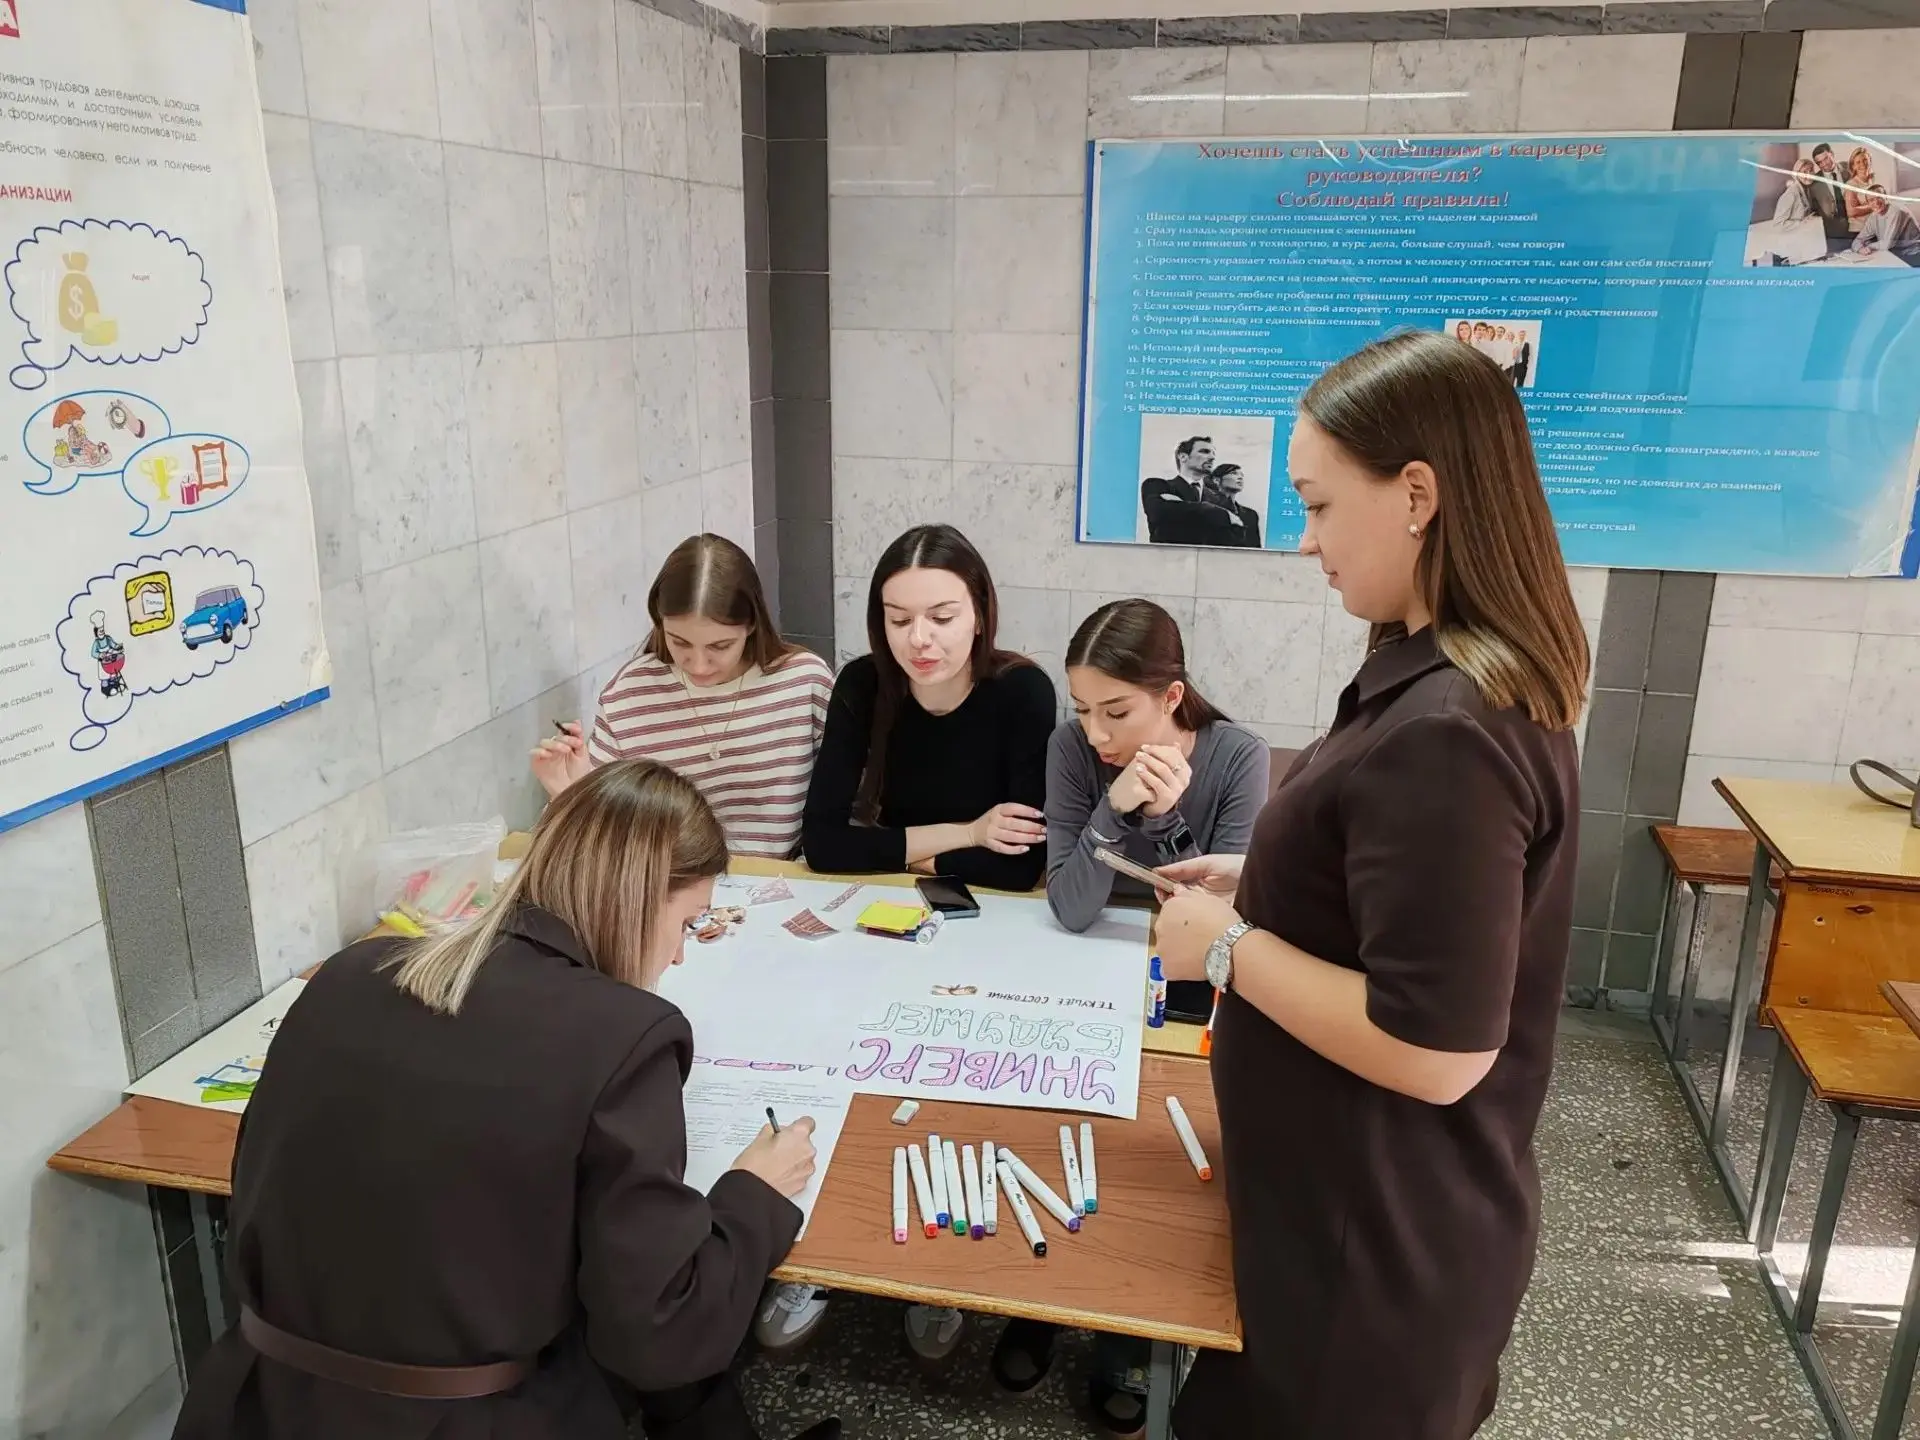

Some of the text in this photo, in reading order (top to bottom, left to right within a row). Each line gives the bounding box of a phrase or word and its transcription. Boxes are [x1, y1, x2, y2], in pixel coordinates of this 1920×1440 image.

[40, 79, 89, 94] трудовая
[106, 121, 130, 132] него
[1198, 143, 1284, 160] Хочешь
[1490, 145, 1502, 157] в
[1508, 143, 1607, 161] карьере
[1308, 167, 1482, 187] руководителя?
[0, 184, 72, 202] АНИЗАЦИИ
[1278, 190, 1509, 211] Соблюдай правила!
[1146, 213, 1185, 221] Шансы
[1205, 214, 1246, 223] карьеру
[1294, 214, 1367, 222] повышаются
[1370, 215, 1376, 223] у
[1428, 214, 1476, 222] наделен
[1480, 213, 1538, 223] харизмой
[1145, 225, 1176, 235] Сразу
[1180, 227, 1217, 235] наладь
[1220, 227, 1266, 235] хорошие
[1147, 239, 1175, 247] Пока
[1259, 240, 1329, 249] технологию,
[1342, 241, 1366, 249] курс
[1369, 241, 1397, 249] дела,
[1402, 240, 1444, 248] больше
[1523, 242, 1565, 250] говори
[1145, 256, 1211, 265] Скромность
[1214, 257, 1265, 266] украшает
[1268, 257, 1305, 265] только
[1308, 258, 1355, 266] сначала,
[1415, 259, 1466, 268] человеку
[1470, 259, 1529, 267] относятся
[1533, 260, 1555, 268] так,
[1559, 259, 1580, 267] как
[1583, 259, 1599, 267] он
[1601, 259, 1623, 268] сам
[1626, 258, 1653, 268] себя
[1656, 259, 1714, 269] поставит
[1144, 273, 1177, 281] После
[1229, 275, 1284, 283] огляделся
[1380, 276, 1428, 284] начинай
[1432, 276, 1520, 285] ликвидировать
[1540, 277, 1601, 286] недочеты,
[1605, 277, 1656, 287] которые
[1659, 278, 1702, 288] увидел
[1706, 278, 1753, 287] свежим
[1757, 278, 1815, 288] взглядом
[1145, 289, 1193, 298] Начинай
[1196, 291, 1234, 299] решать
[1238, 290, 1273, 299] любые
[1277, 291, 1333, 301] проблемы
[1353, 294, 1410, 303] принципу
[1436, 295, 1489, 303] простого
[1511, 295, 1577, 304] сложному»
[1144, 302, 1169, 310] Если
[1214, 303, 1263, 312] погубить
[1303, 304, 1328, 312] свой
[1332, 306, 1391, 315] авторитет,
[1396, 307, 1449, 315] пригласи
[1467, 307, 1507, 316] работу
[1510, 307, 1551, 318] друзей
[1565, 308, 1658, 319] родственников
[1144, 314, 1199, 324] Формируй
[1202, 316, 1246, 325] команду
[1266, 317, 1380, 326] единомышленников
[1143, 327, 1178, 337] Опора
[1143, 343, 1200, 353] Используй
[1203, 345, 1283, 354] информаторов
[1159, 357, 1207, 365] стремись
[1220, 358, 1245, 366] роли
[1141, 368, 1155, 376] Не
[1191, 370, 1268, 379] непрошеными
[1156, 381, 1198, 389] уступай
[1201, 382, 1248, 391] соблазну
[1139, 392, 1154, 400] Не
[1211, 395, 1294, 404] демонстрацией
[1537, 391, 1688, 403] своих семейных проблем
[1138, 403, 1176, 412] Всякую
[1179, 406, 1231, 415] разумную
[1234, 407, 1263, 415] идею
[1575, 405, 1596, 413] для
[1600, 406, 1686, 415] подчиненных.
[1548, 429, 1624, 439] решения сам
[1554, 442, 1820, 457] дело должно быть вознаграждено, каждое
[1605, 478, 1620, 486] но
[1721, 481, 1781, 491] взаимной
[1588, 487, 1616, 496] дело
[1589, 522, 1636, 532] спускай
[986, 991, 1117, 1010] ТЕКУЩЕЕ СОСТОЯНИЕ
[846, 1038, 1116, 1105] УНИВЕРС
